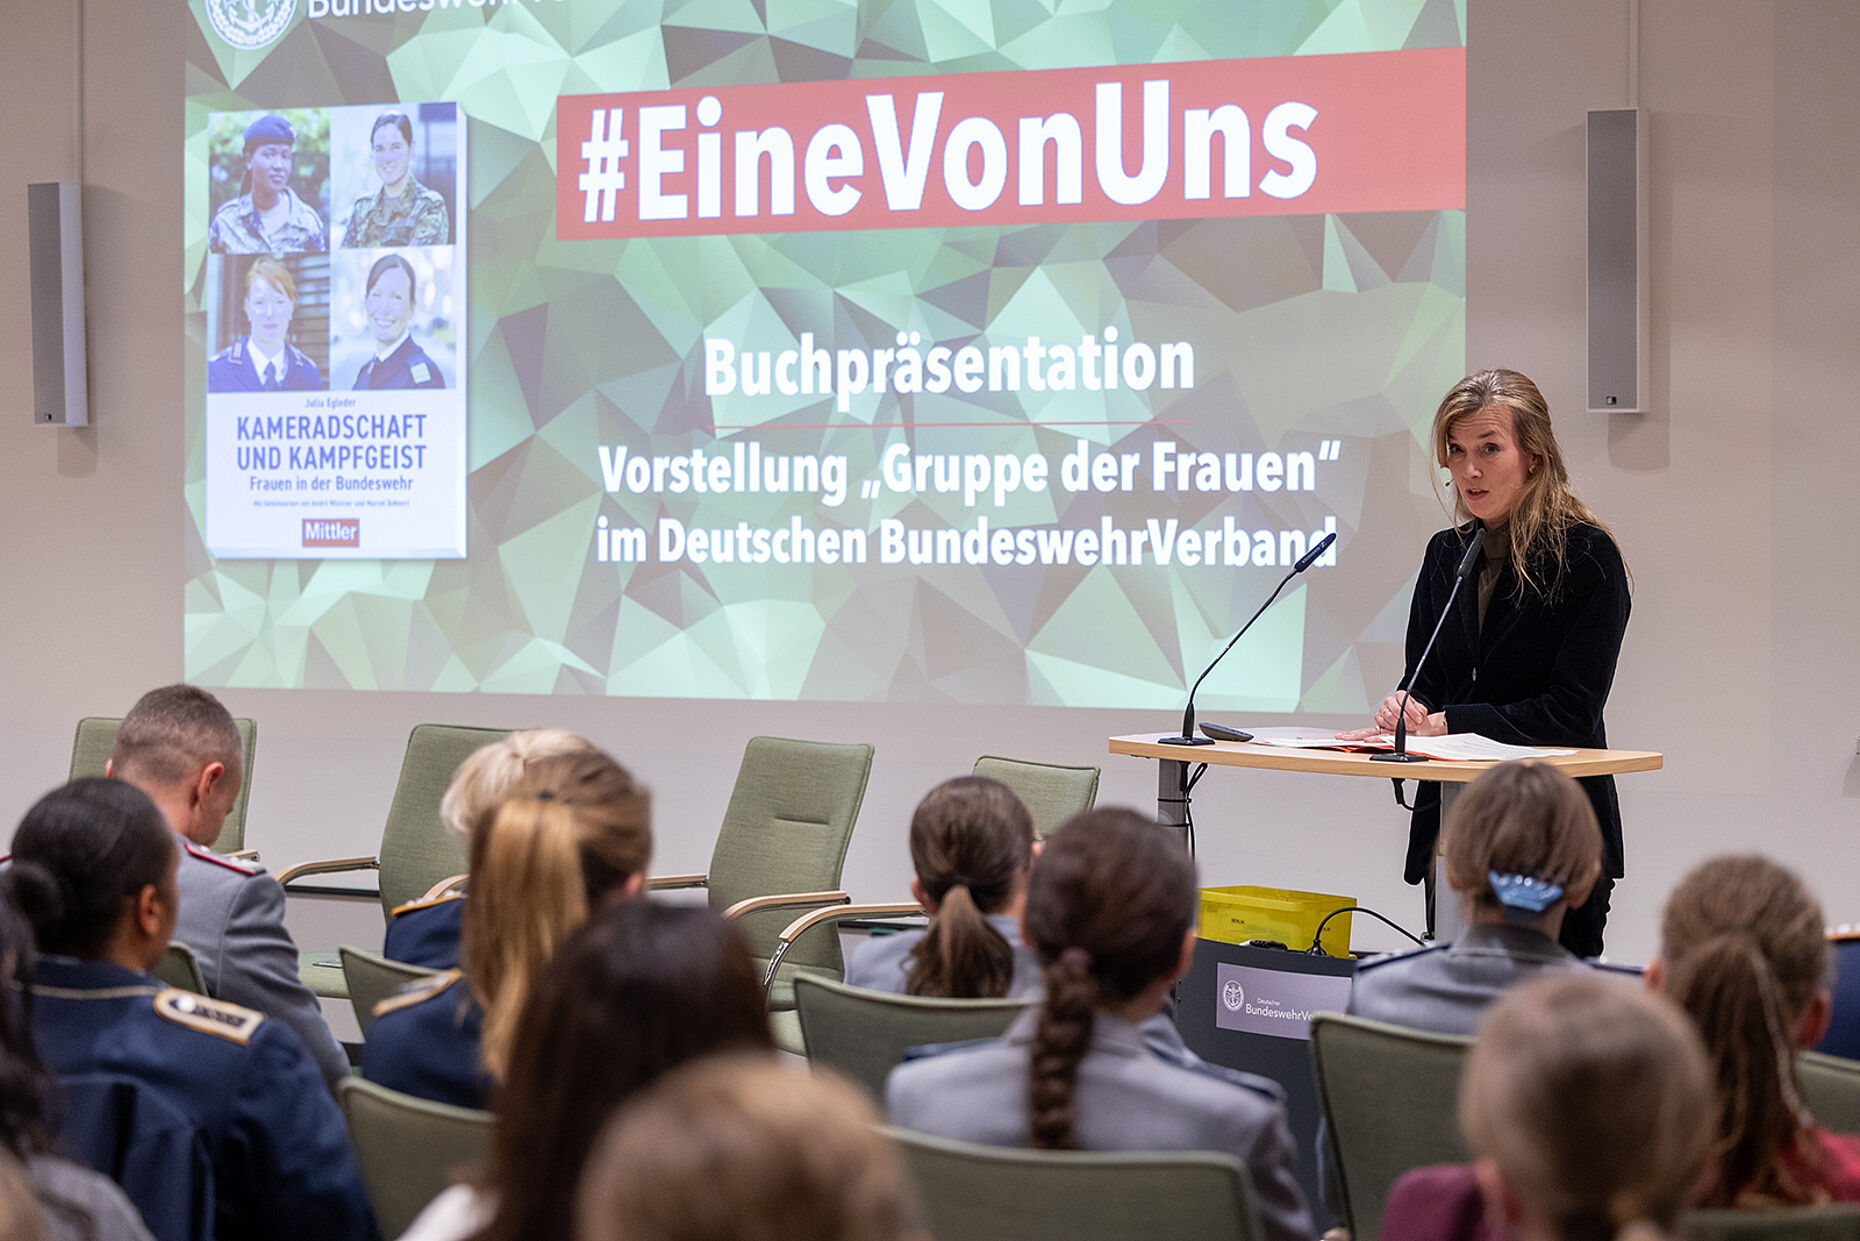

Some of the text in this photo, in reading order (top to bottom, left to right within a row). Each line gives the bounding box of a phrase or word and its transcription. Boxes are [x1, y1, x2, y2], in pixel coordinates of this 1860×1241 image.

[578, 79, 1319, 222] #EineVonUns
[704, 325, 1195, 413] Buchpräsentation
[237, 414, 428, 440] KAMERADSCHAFT
[237, 445, 428, 470] UND KAMPFGEIST
[250, 475, 414, 491] Frauen in der Bundeswehr
[597, 441, 848, 507] Vorstellung
[861, 442, 1049, 507] „Gruppe
[1060, 439, 1140, 493] der
[305, 522, 358, 541] Mittler
[597, 515, 647, 563] im
[658, 515, 868, 565] Deutschen
[879, 515, 1337, 567] BundeswehrVerband
[1245, 1003, 1314, 1021] BundeswehrVe
